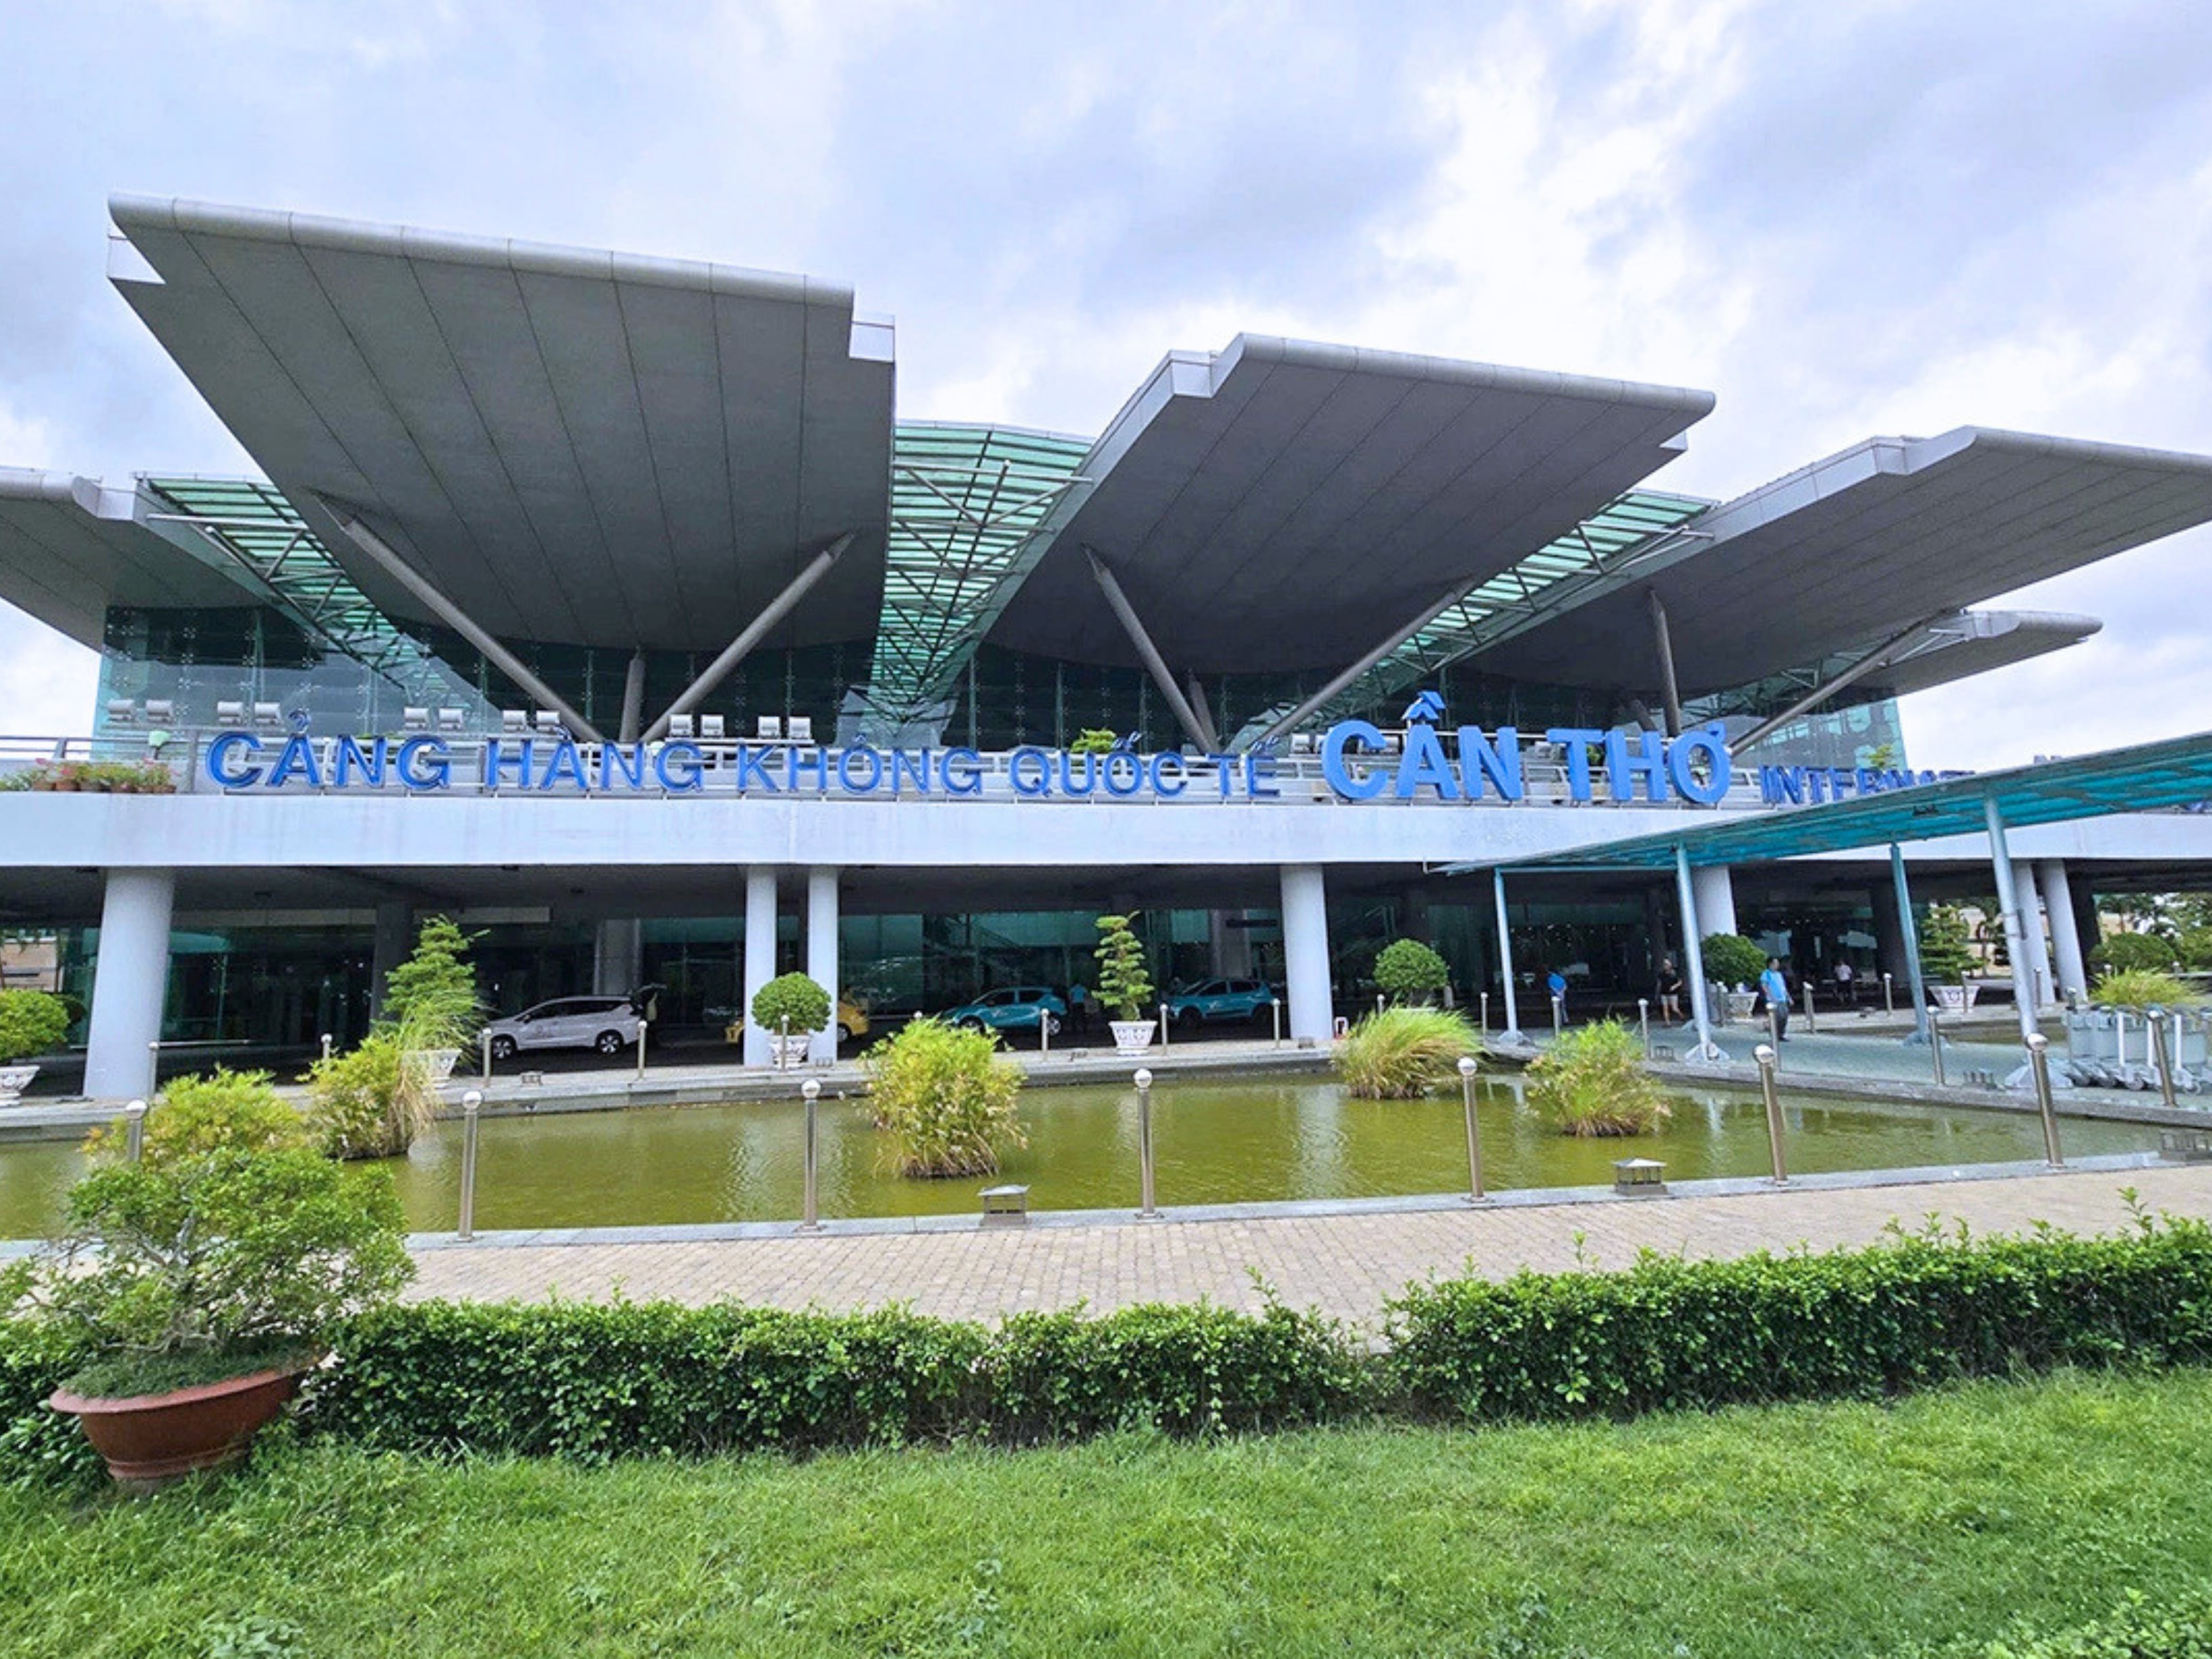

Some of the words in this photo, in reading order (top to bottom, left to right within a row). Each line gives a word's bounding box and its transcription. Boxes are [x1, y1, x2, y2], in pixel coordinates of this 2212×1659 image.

[206, 709, 453, 790] CẢNG
[483, 724, 707, 792] HÀNG
[736, 733, 982, 795] KHÔNG
[1009, 731, 1186, 799] QUỐC
[1207, 736, 1281, 798] TẾ
[1321, 691, 1522, 801] CẦN
[1546, 723, 1731, 804] THƠ
